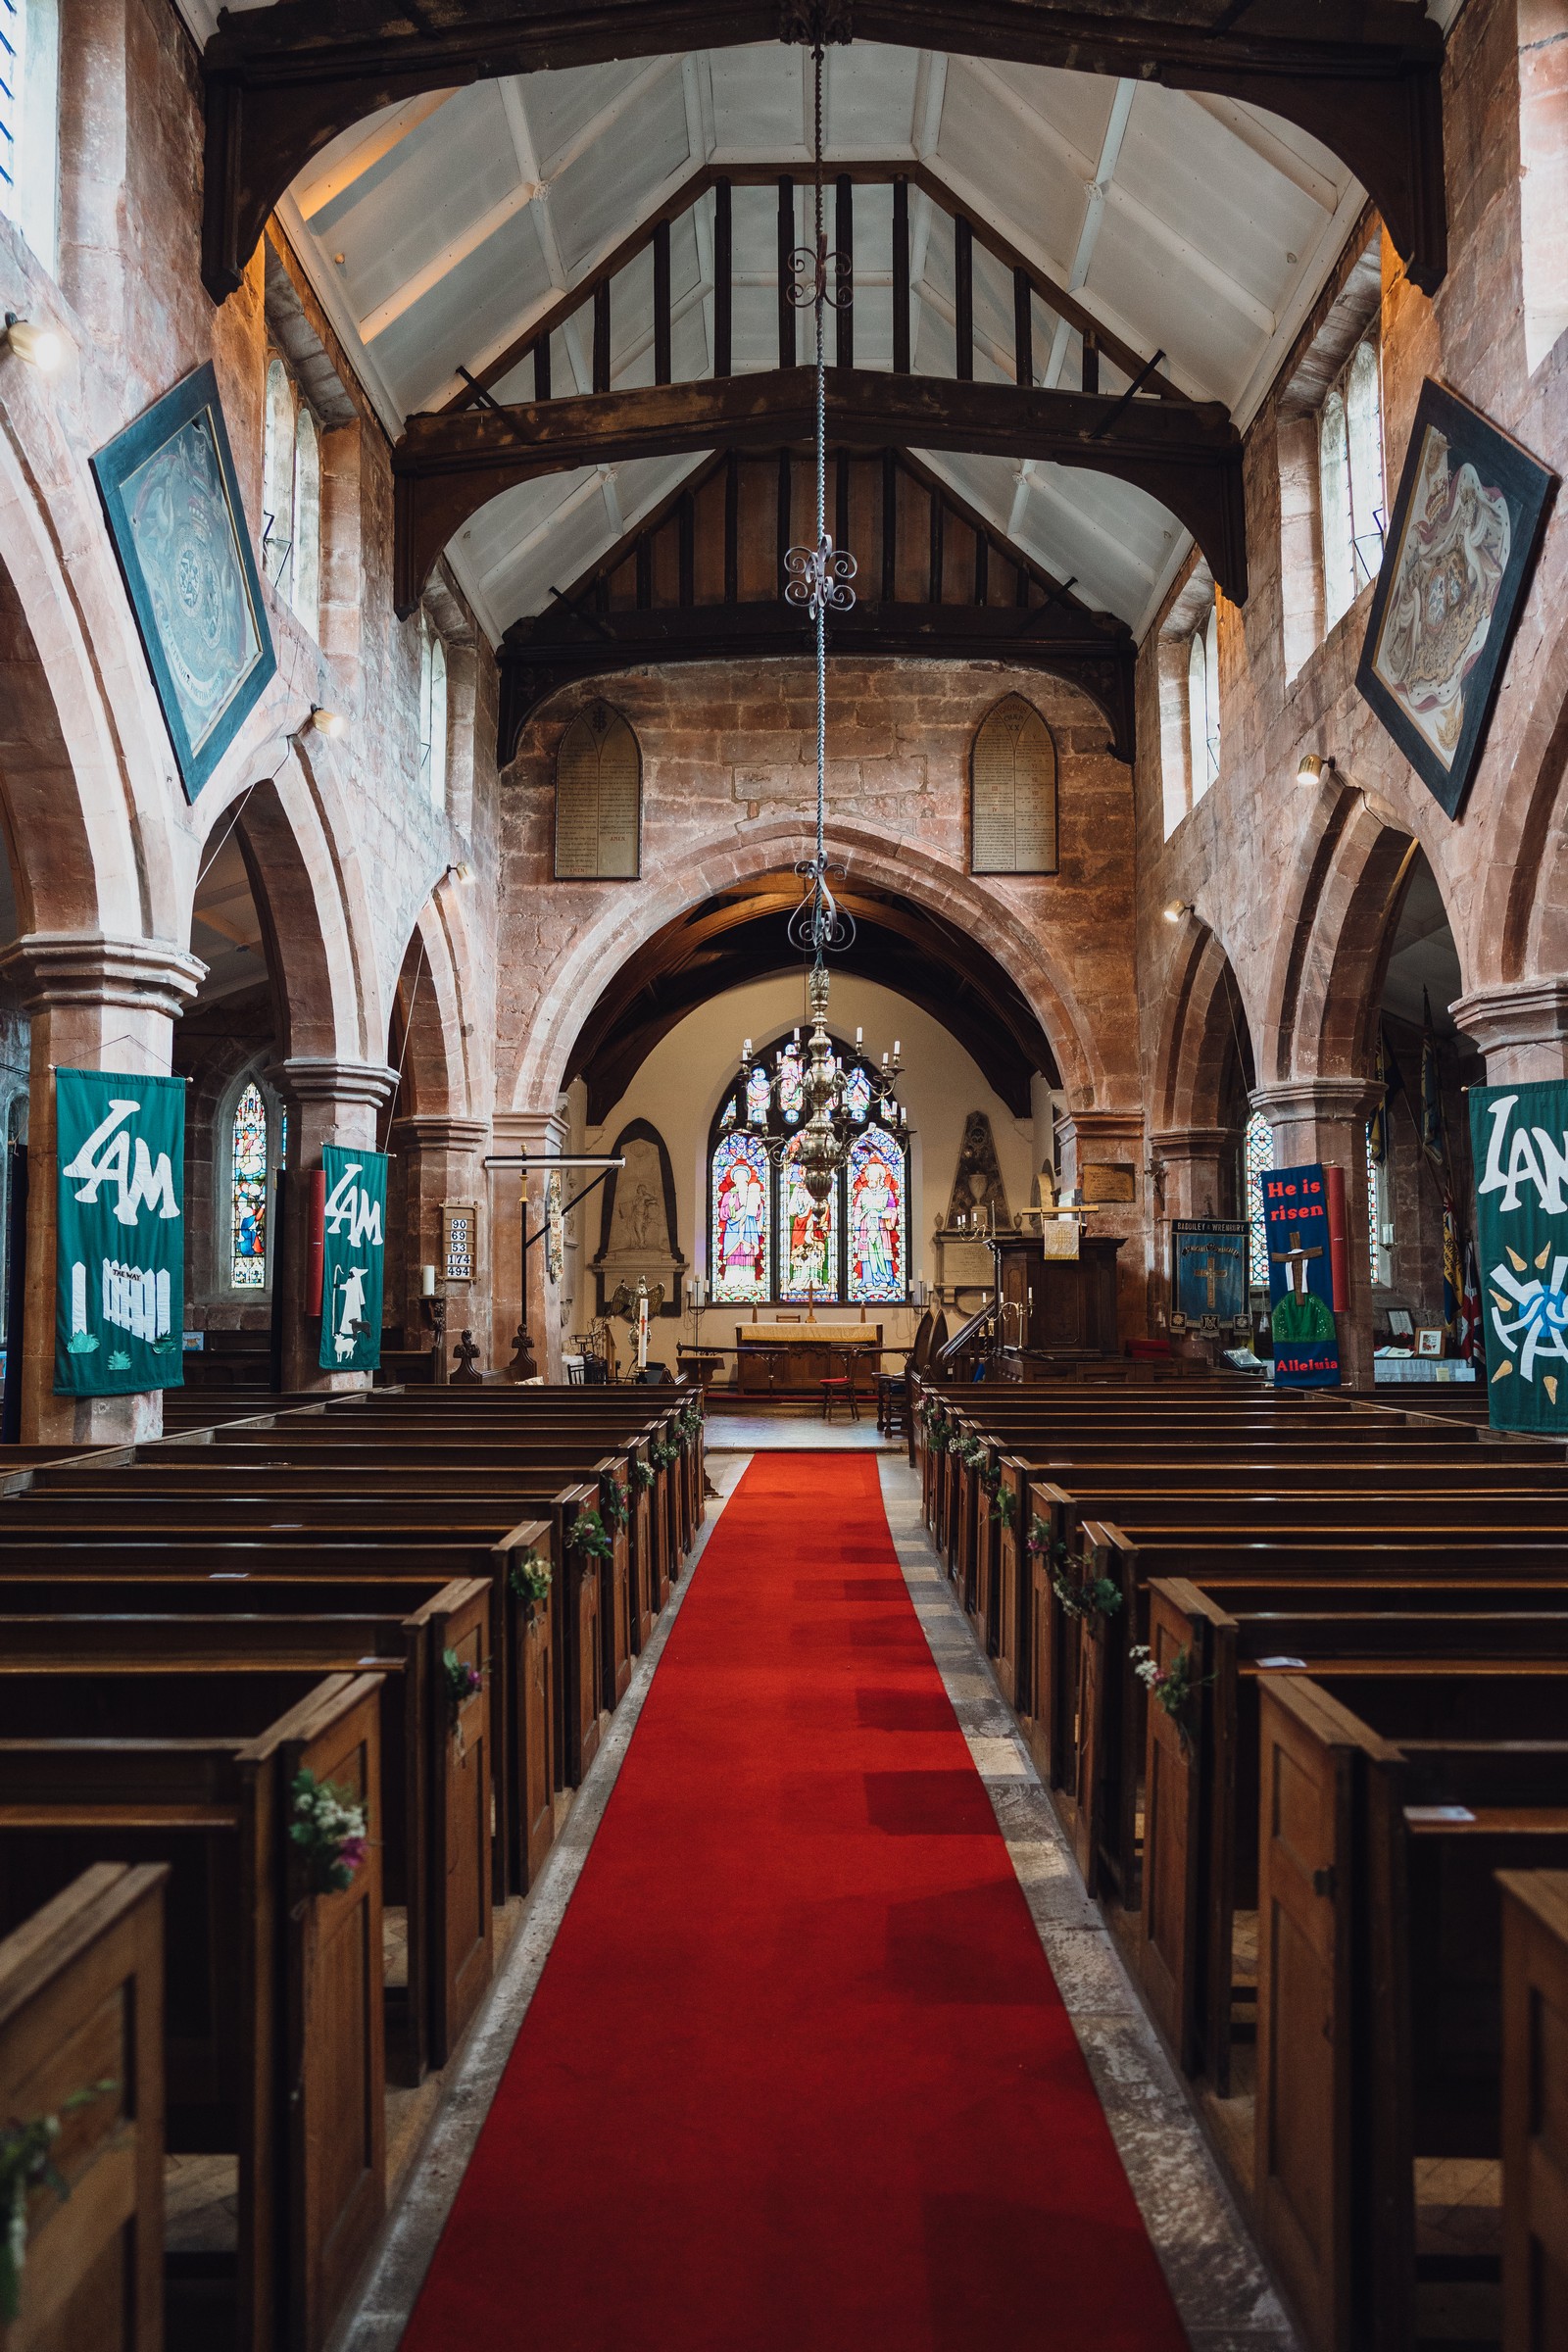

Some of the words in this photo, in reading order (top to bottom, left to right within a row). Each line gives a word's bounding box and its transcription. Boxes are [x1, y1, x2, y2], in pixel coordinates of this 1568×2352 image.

[1267, 1181, 1297, 1199] He
[1302, 1179, 1321, 1195] is
[1270, 1203, 1324, 1222] risen
[452, 1219, 466, 1229] 90
[451, 1231, 466, 1240] 69
[452, 1243, 466, 1252] 53
[449, 1254, 470, 1264] 174
[112, 1268, 125, 1278] THE
[125, 1271, 141, 1282] WAY
[448, 1267, 469, 1276] 494
[1276, 1357, 1339, 1373] Alleluia
